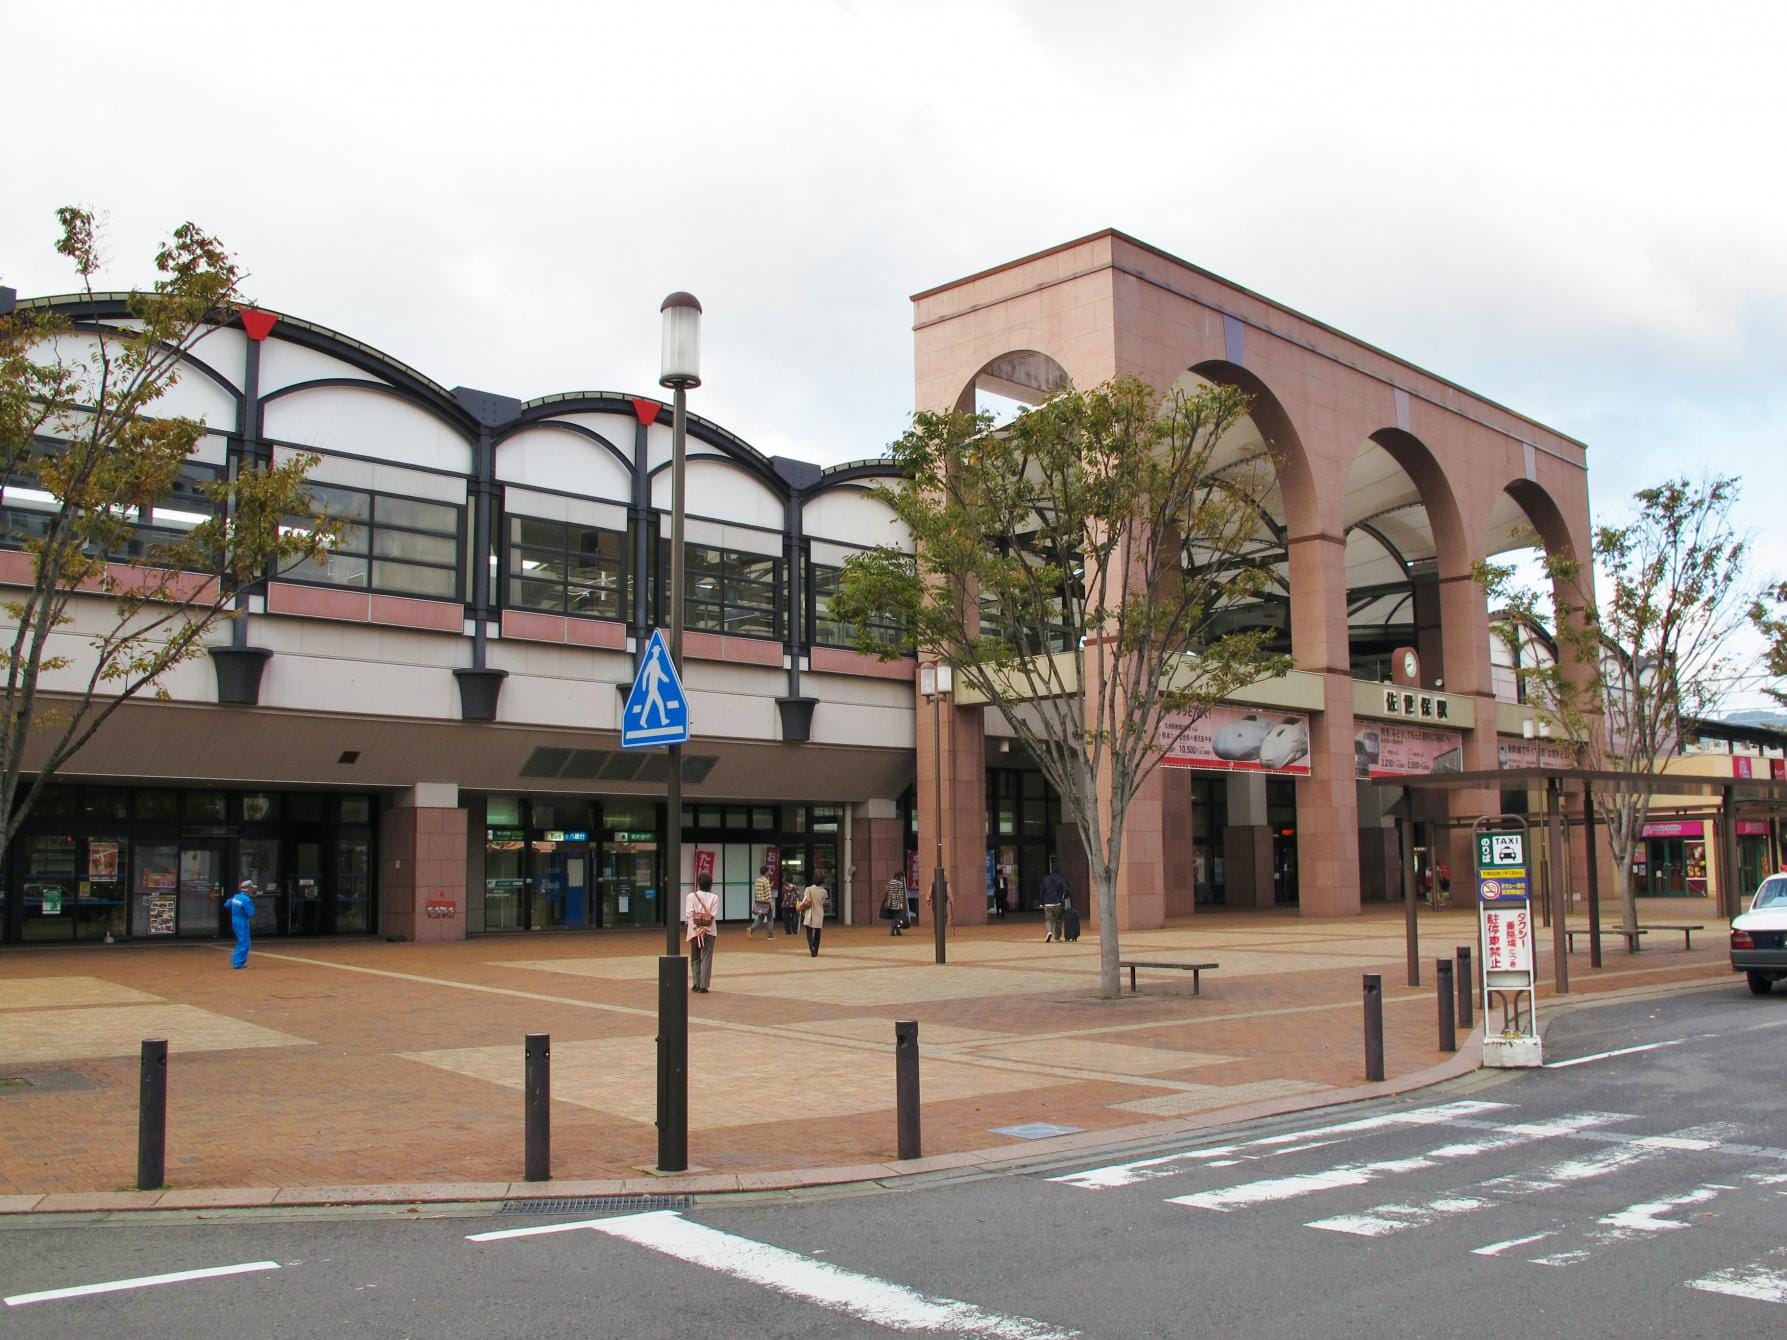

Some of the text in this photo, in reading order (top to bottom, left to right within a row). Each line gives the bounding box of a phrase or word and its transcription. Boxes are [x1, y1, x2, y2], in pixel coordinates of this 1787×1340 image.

[1386, 691, 1448, 719] 佐世保駅
[1480, 837, 1491, 864] のりば
[1495, 836, 1519, 845] TAXI
[1487, 914, 1502, 969] 駐停車禁止
[1517, 912, 1528, 949] タクシー
